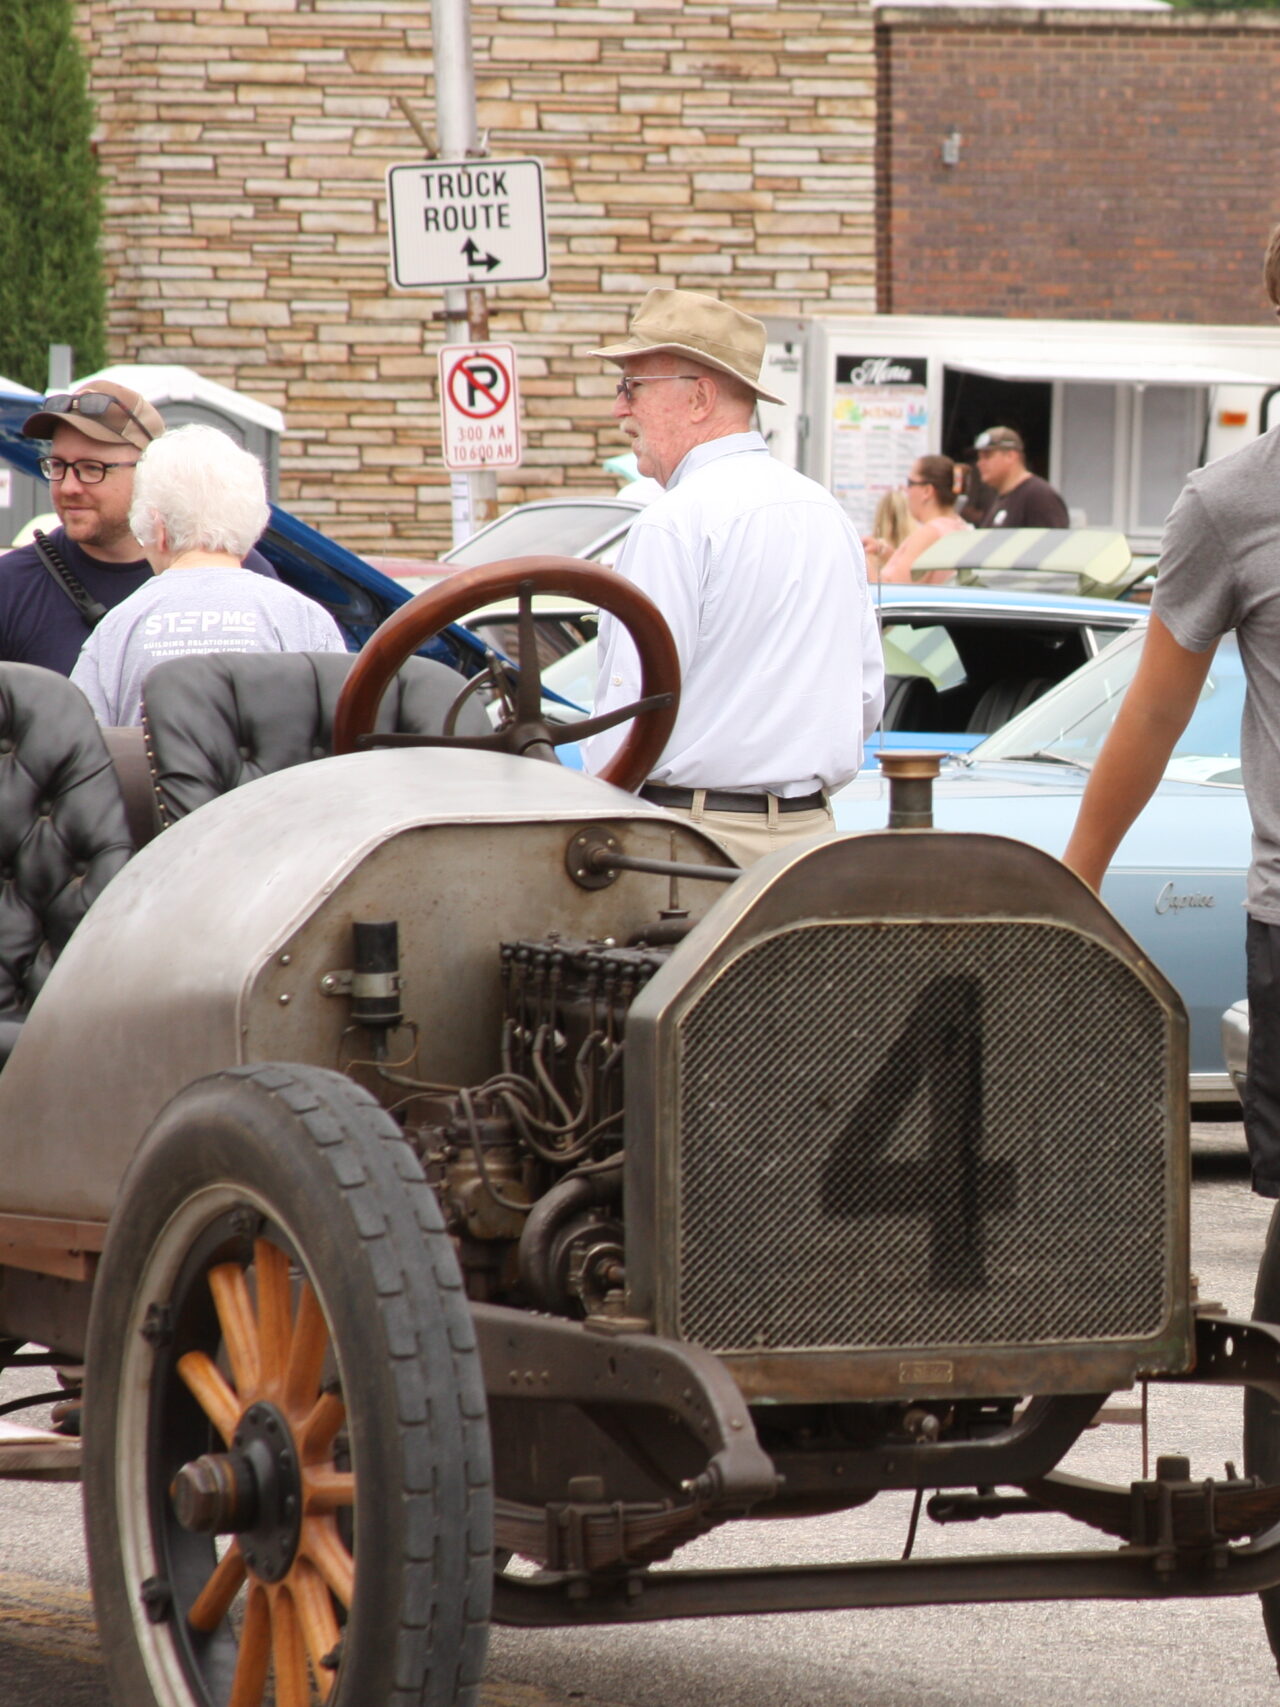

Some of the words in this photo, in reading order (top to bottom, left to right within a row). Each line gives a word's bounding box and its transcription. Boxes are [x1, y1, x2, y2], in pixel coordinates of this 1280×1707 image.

[420, 170, 509, 199] TRUCK
[423, 203, 511, 233] ROUTE
[850, 357, 912, 385] Menu
[458, 425, 483, 442] 3:00
[488, 424, 505, 440] AM
[453, 445, 467, 461] TO
[497, 442, 513, 459] AM
[143, 640, 185, 650] BUILDING
[820, 973, 1017, 1291] 4
